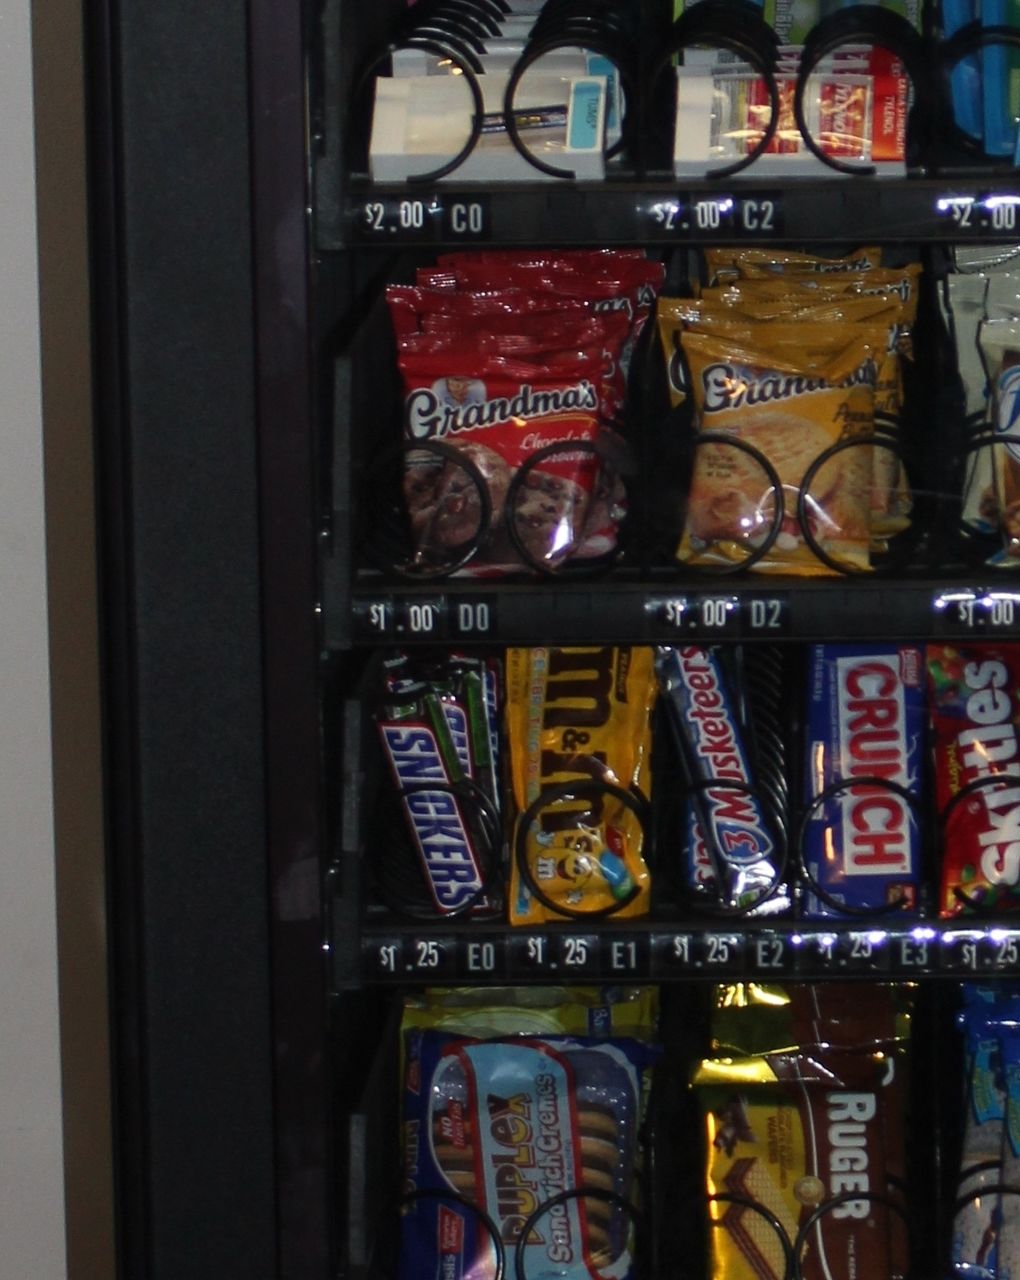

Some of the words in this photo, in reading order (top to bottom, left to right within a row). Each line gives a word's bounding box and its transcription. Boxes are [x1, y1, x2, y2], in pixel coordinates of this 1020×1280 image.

[883, 96, 896, 135] TYLENOL
[365, 200, 424, 233] $2.00
[451, 204, 483, 233] C0
[744, 201, 774, 231] C2
[406, 380, 598, 440] Grandma's
[370, 603, 433, 631] $1.00
[460, 603, 490, 631] D0
[752, 600, 782, 628] D2
[845, 662, 906, 867] CRUNCH
[720, 829, 760, 854] 3
[380, 940, 439, 972] $1.25
[468, 943, 495, 970] E0
[528, 936, 587, 969] $1.25
[612, 941, 636, 969] E1
[674, 936, 729, 968] $1.25
[757, 940, 784, 968] E2
[901, 937, 929, 965] E3
[440, 1116, 453, 1138] NO
[824, 1092, 878, 1221] RUGER
